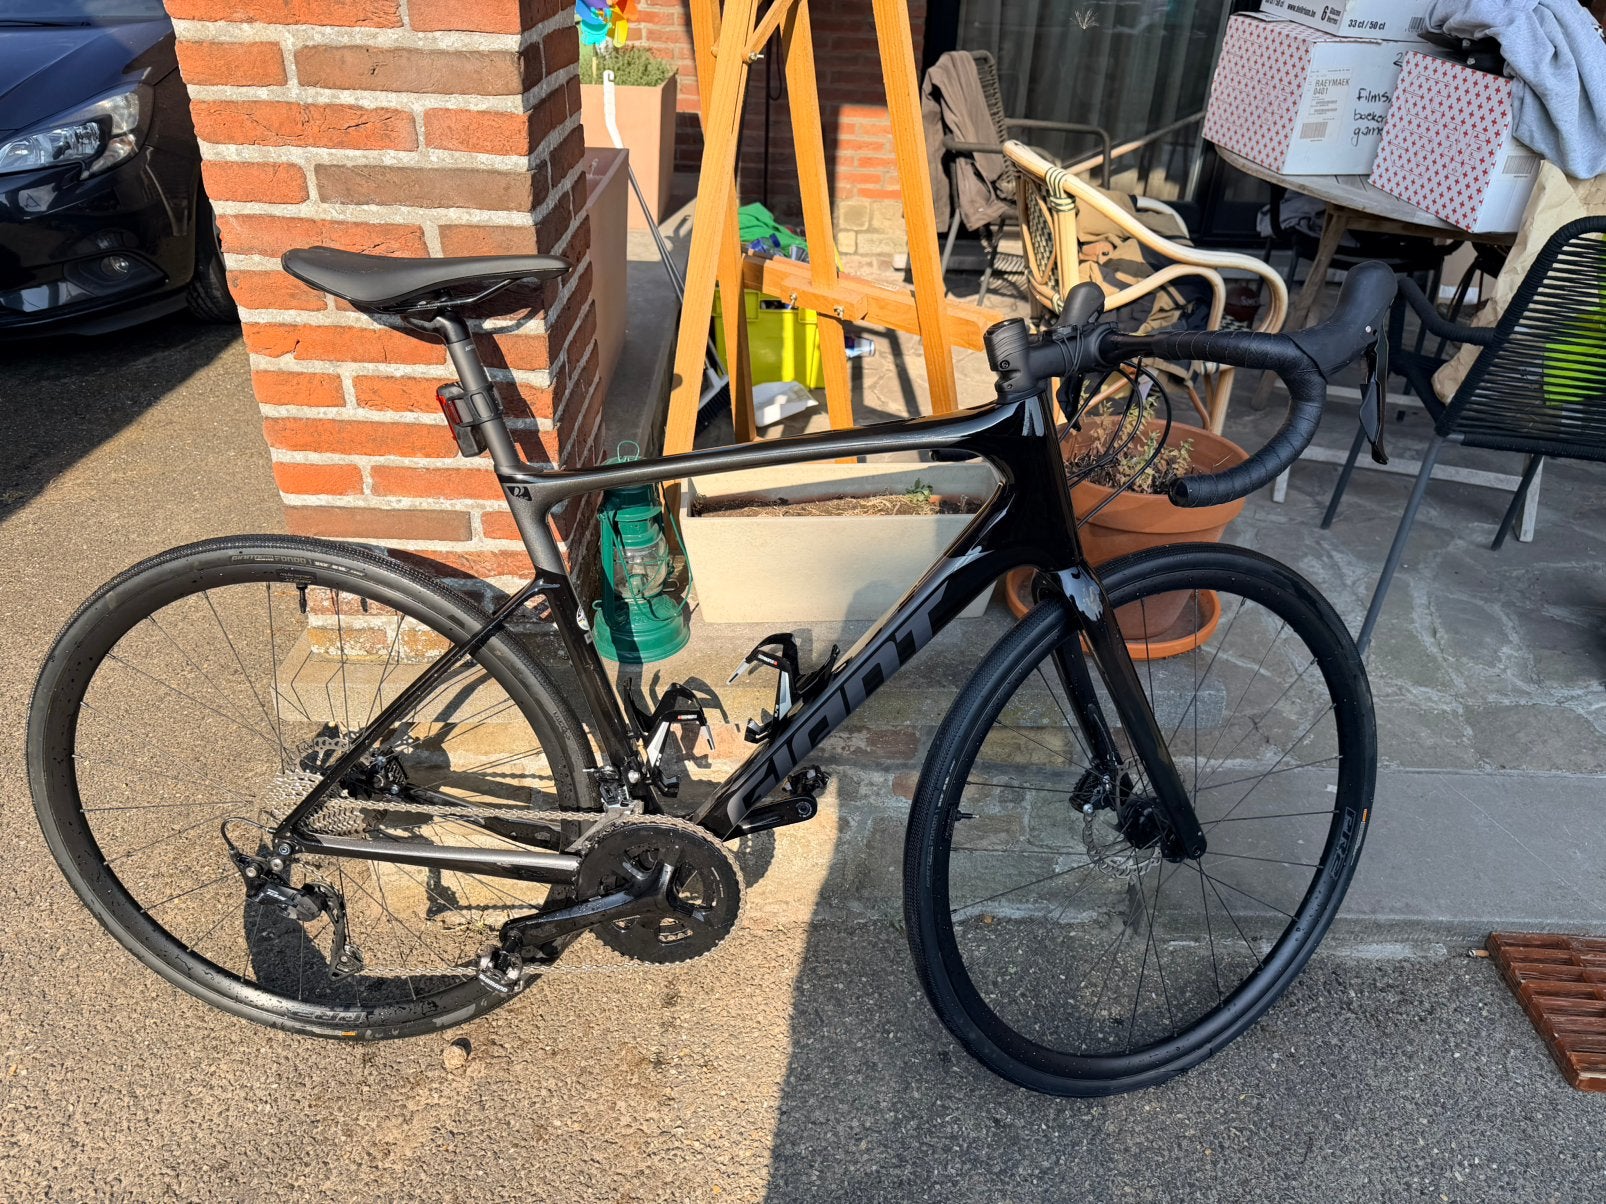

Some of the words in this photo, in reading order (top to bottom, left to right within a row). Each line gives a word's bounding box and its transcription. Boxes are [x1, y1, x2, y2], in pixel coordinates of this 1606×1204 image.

[1321, 5, 1329, 21] 6
[1348, 19, 1358, 28] 33
[1357, 20, 1366, 29] cl
[1369, 20, 1379, 30] 50
[1378, 22, 1386, 30] cl
[1314, 78, 1350, 87] RAEYMAEK
[1312, 87, 1328, 96] 0401
[479, 974, 508, 992] SHIMANO
